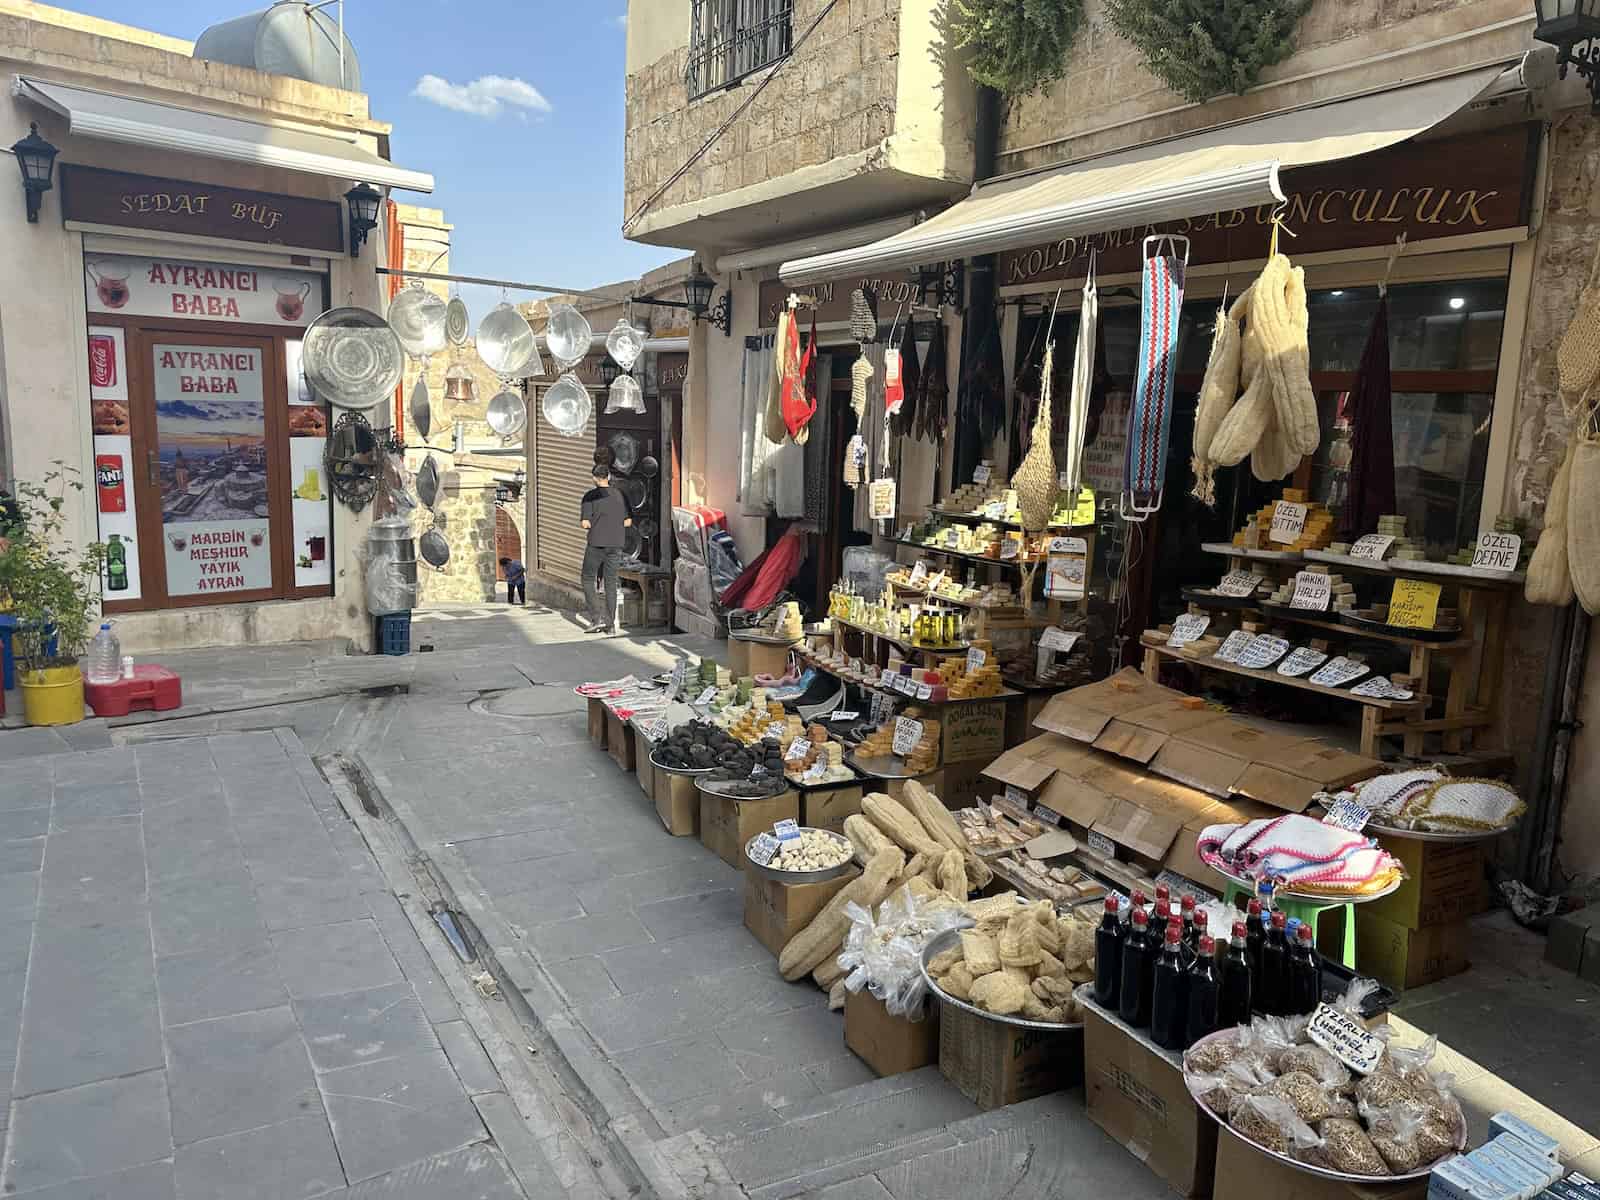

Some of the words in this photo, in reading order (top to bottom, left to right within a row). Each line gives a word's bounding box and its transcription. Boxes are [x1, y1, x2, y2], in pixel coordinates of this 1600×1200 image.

[119, 192, 210, 215] SEDAT
[231, 202, 283, 230] BUF
[147, 263, 258, 292] AYRANCI
[171, 293, 241, 318] BABA
[160, 352, 254, 371] AYRANCI
[180, 375, 239, 393] BABA
[190, 546, 248, 562] MEŞHUR
[1472, 549, 1514, 567] DEFNE
[199, 561, 241, 575] YAYIK
[197, 575, 245, 590] AYRAN
[1296, 586, 1327, 599] HALEP
